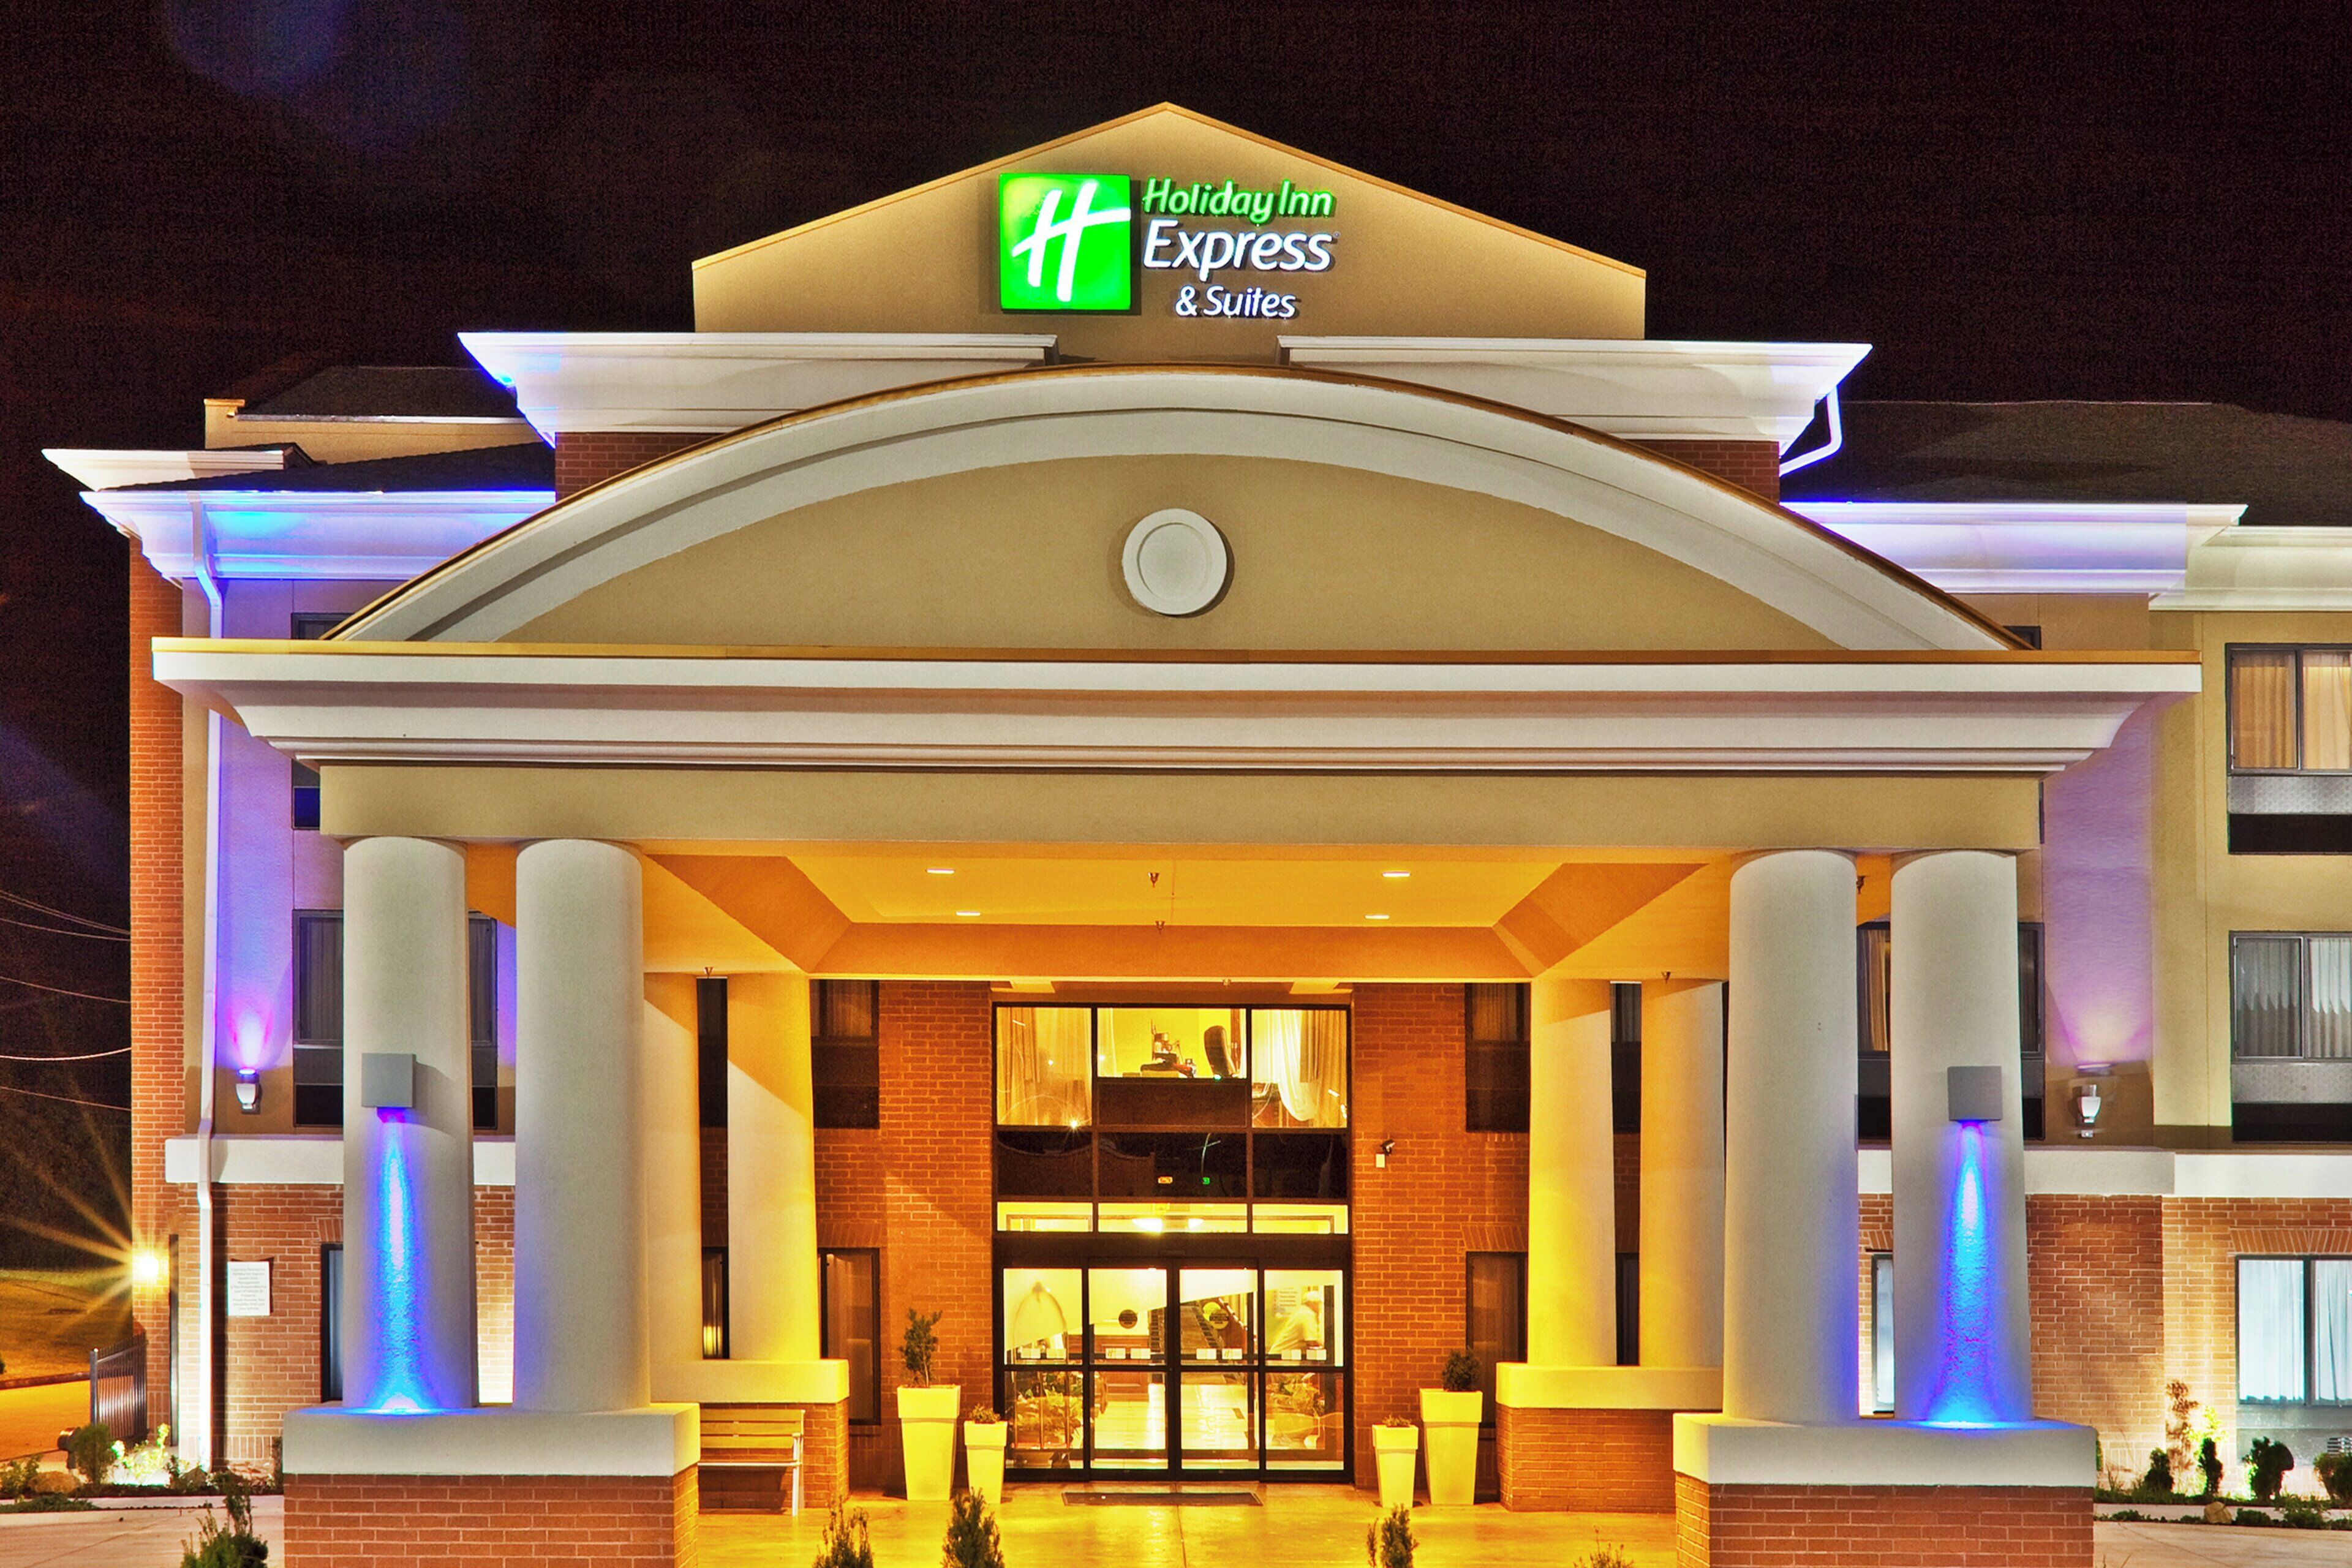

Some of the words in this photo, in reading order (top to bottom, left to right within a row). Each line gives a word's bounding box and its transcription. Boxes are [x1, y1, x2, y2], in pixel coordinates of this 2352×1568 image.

[1142, 176, 1275, 224] Holiday
[1278, 178, 1333, 216] Inn
[1143, 217, 1334, 282] Express
[1174, 285, 1197, 316] &
[1202, 285, 1296, 318] Suites
